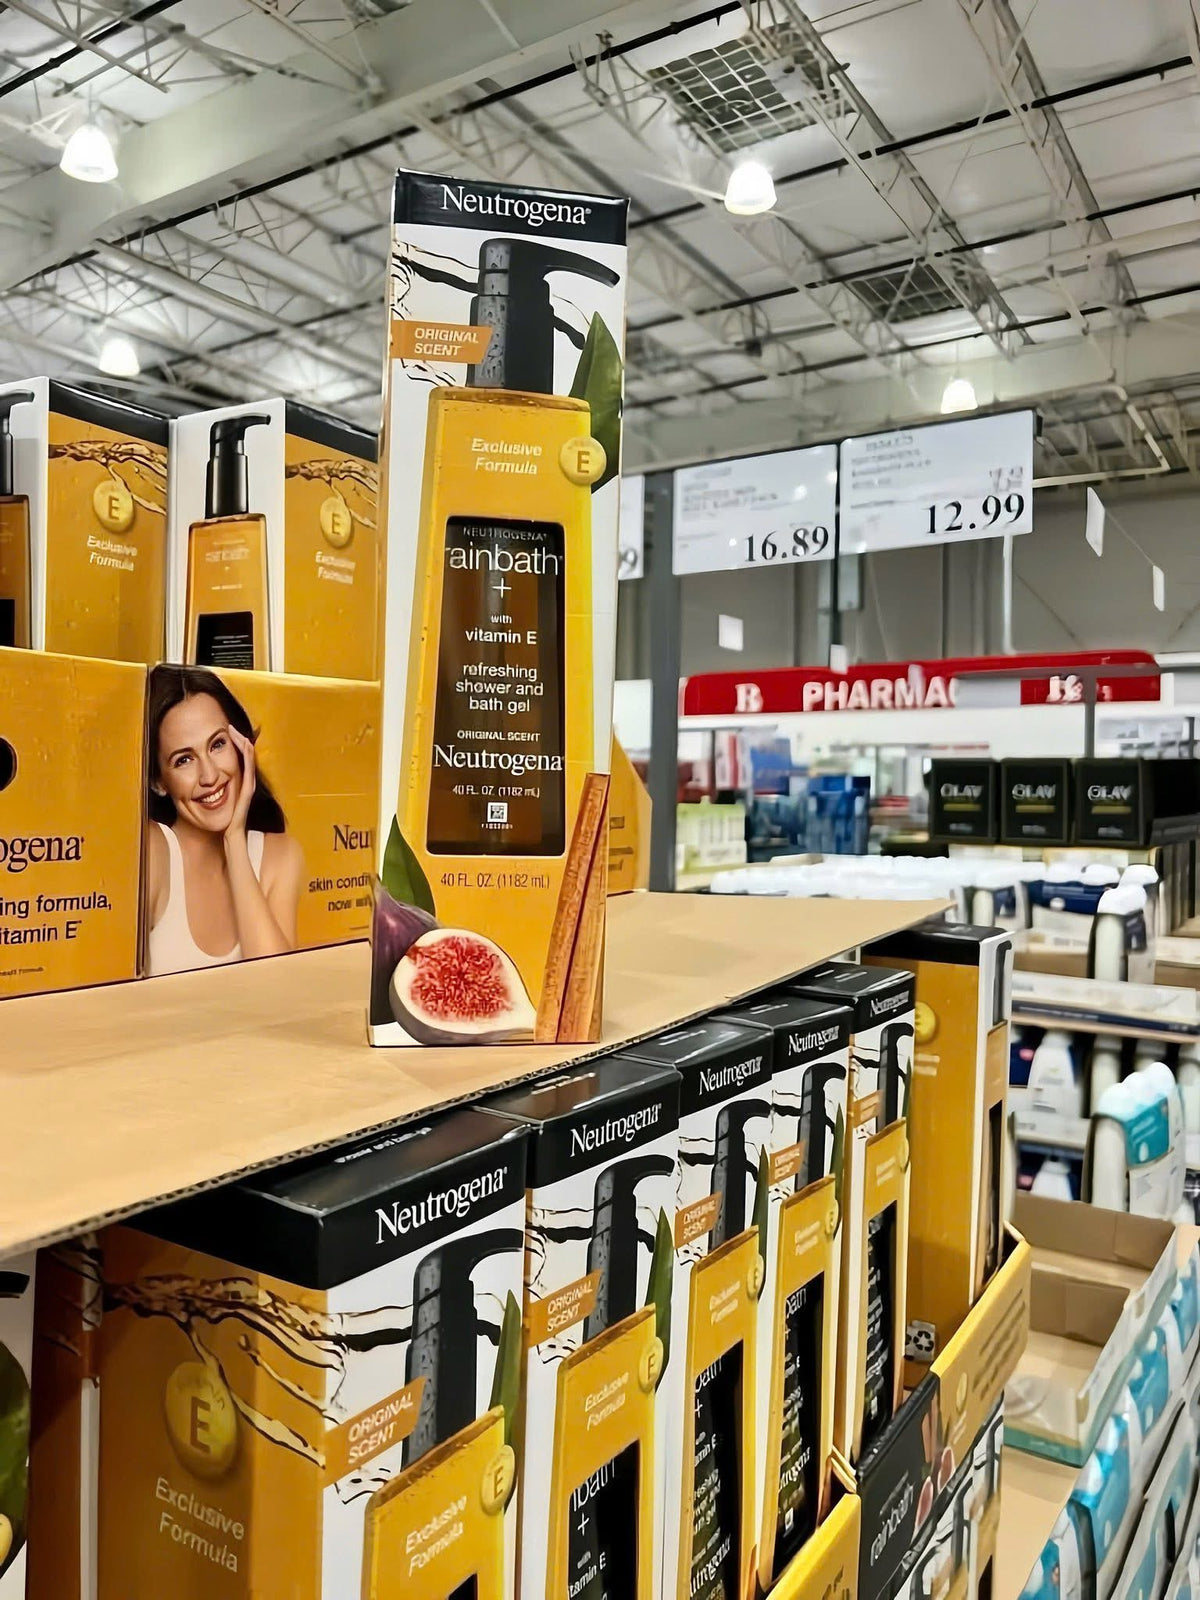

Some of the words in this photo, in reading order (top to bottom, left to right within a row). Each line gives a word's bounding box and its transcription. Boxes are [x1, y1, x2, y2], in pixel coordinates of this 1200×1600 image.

[441, 184, 589, 227] Neutrogena
[414, 327, 479, 344] ORIGINAL
[414, 343, 461, 356] SCENT
[471, 438, 542, 457] Exclusive
[476, 457, 538, 475] Formula
[577, 450, 590, 474] E
[108, 495, 120, 522] E
[922, 493, 1025, 534] 12.99
[331, 513, 342, 535] E
[463, 526, 547, 541] NEUTROGENA
[744, 526, 829, 562] 16.89
[89, 551, 135, 571] Formula
[491, 615, 512, 624] with
[465, 628, 521, 644] vitamin
[526, 631, 537, 645] E
[463, 662, 537, 682] refreshing
[455, 679, 512, 693] shower
[515, 683, 544, 696] and
[469, 696, 502, 711] bath
[508, 699, 530, 714] gel
[457, 730, 505, 741] ORIGINAL
[507, 732, 540, 742] SCENT
[433, 744, 563, 776] Neutrogena
[453, 785, 464, 795] 40
[309, 878, 333, 893] skin
[440, 873, 455, 887] 40
[497, 873, 528, 889] (1182
[36, 891, 112, 914] formula,
[328, 899, 352, 911] now
[570, 1103, 661, 1158] Neutrogena
[375, 1168, 507, 1245] Neutrogena
[547, 1280, 593, 1314] ORIGINAL
[547, 1302, 580, 1332] SCENT
[189, 1396, 211, 1454] E
[348, 1392, 414, 1442] ORIGINAL
[348, 1422, 397, 1464] SCENT
[493, 1466, 504, 1499] E
[155, 1477, 245, 1541] Exclusive
[405, 1495, 467, 1554] Exclusive
[159, 1515, 238, 1574] Formula
[408, 1522, 464, 1577] Formula
